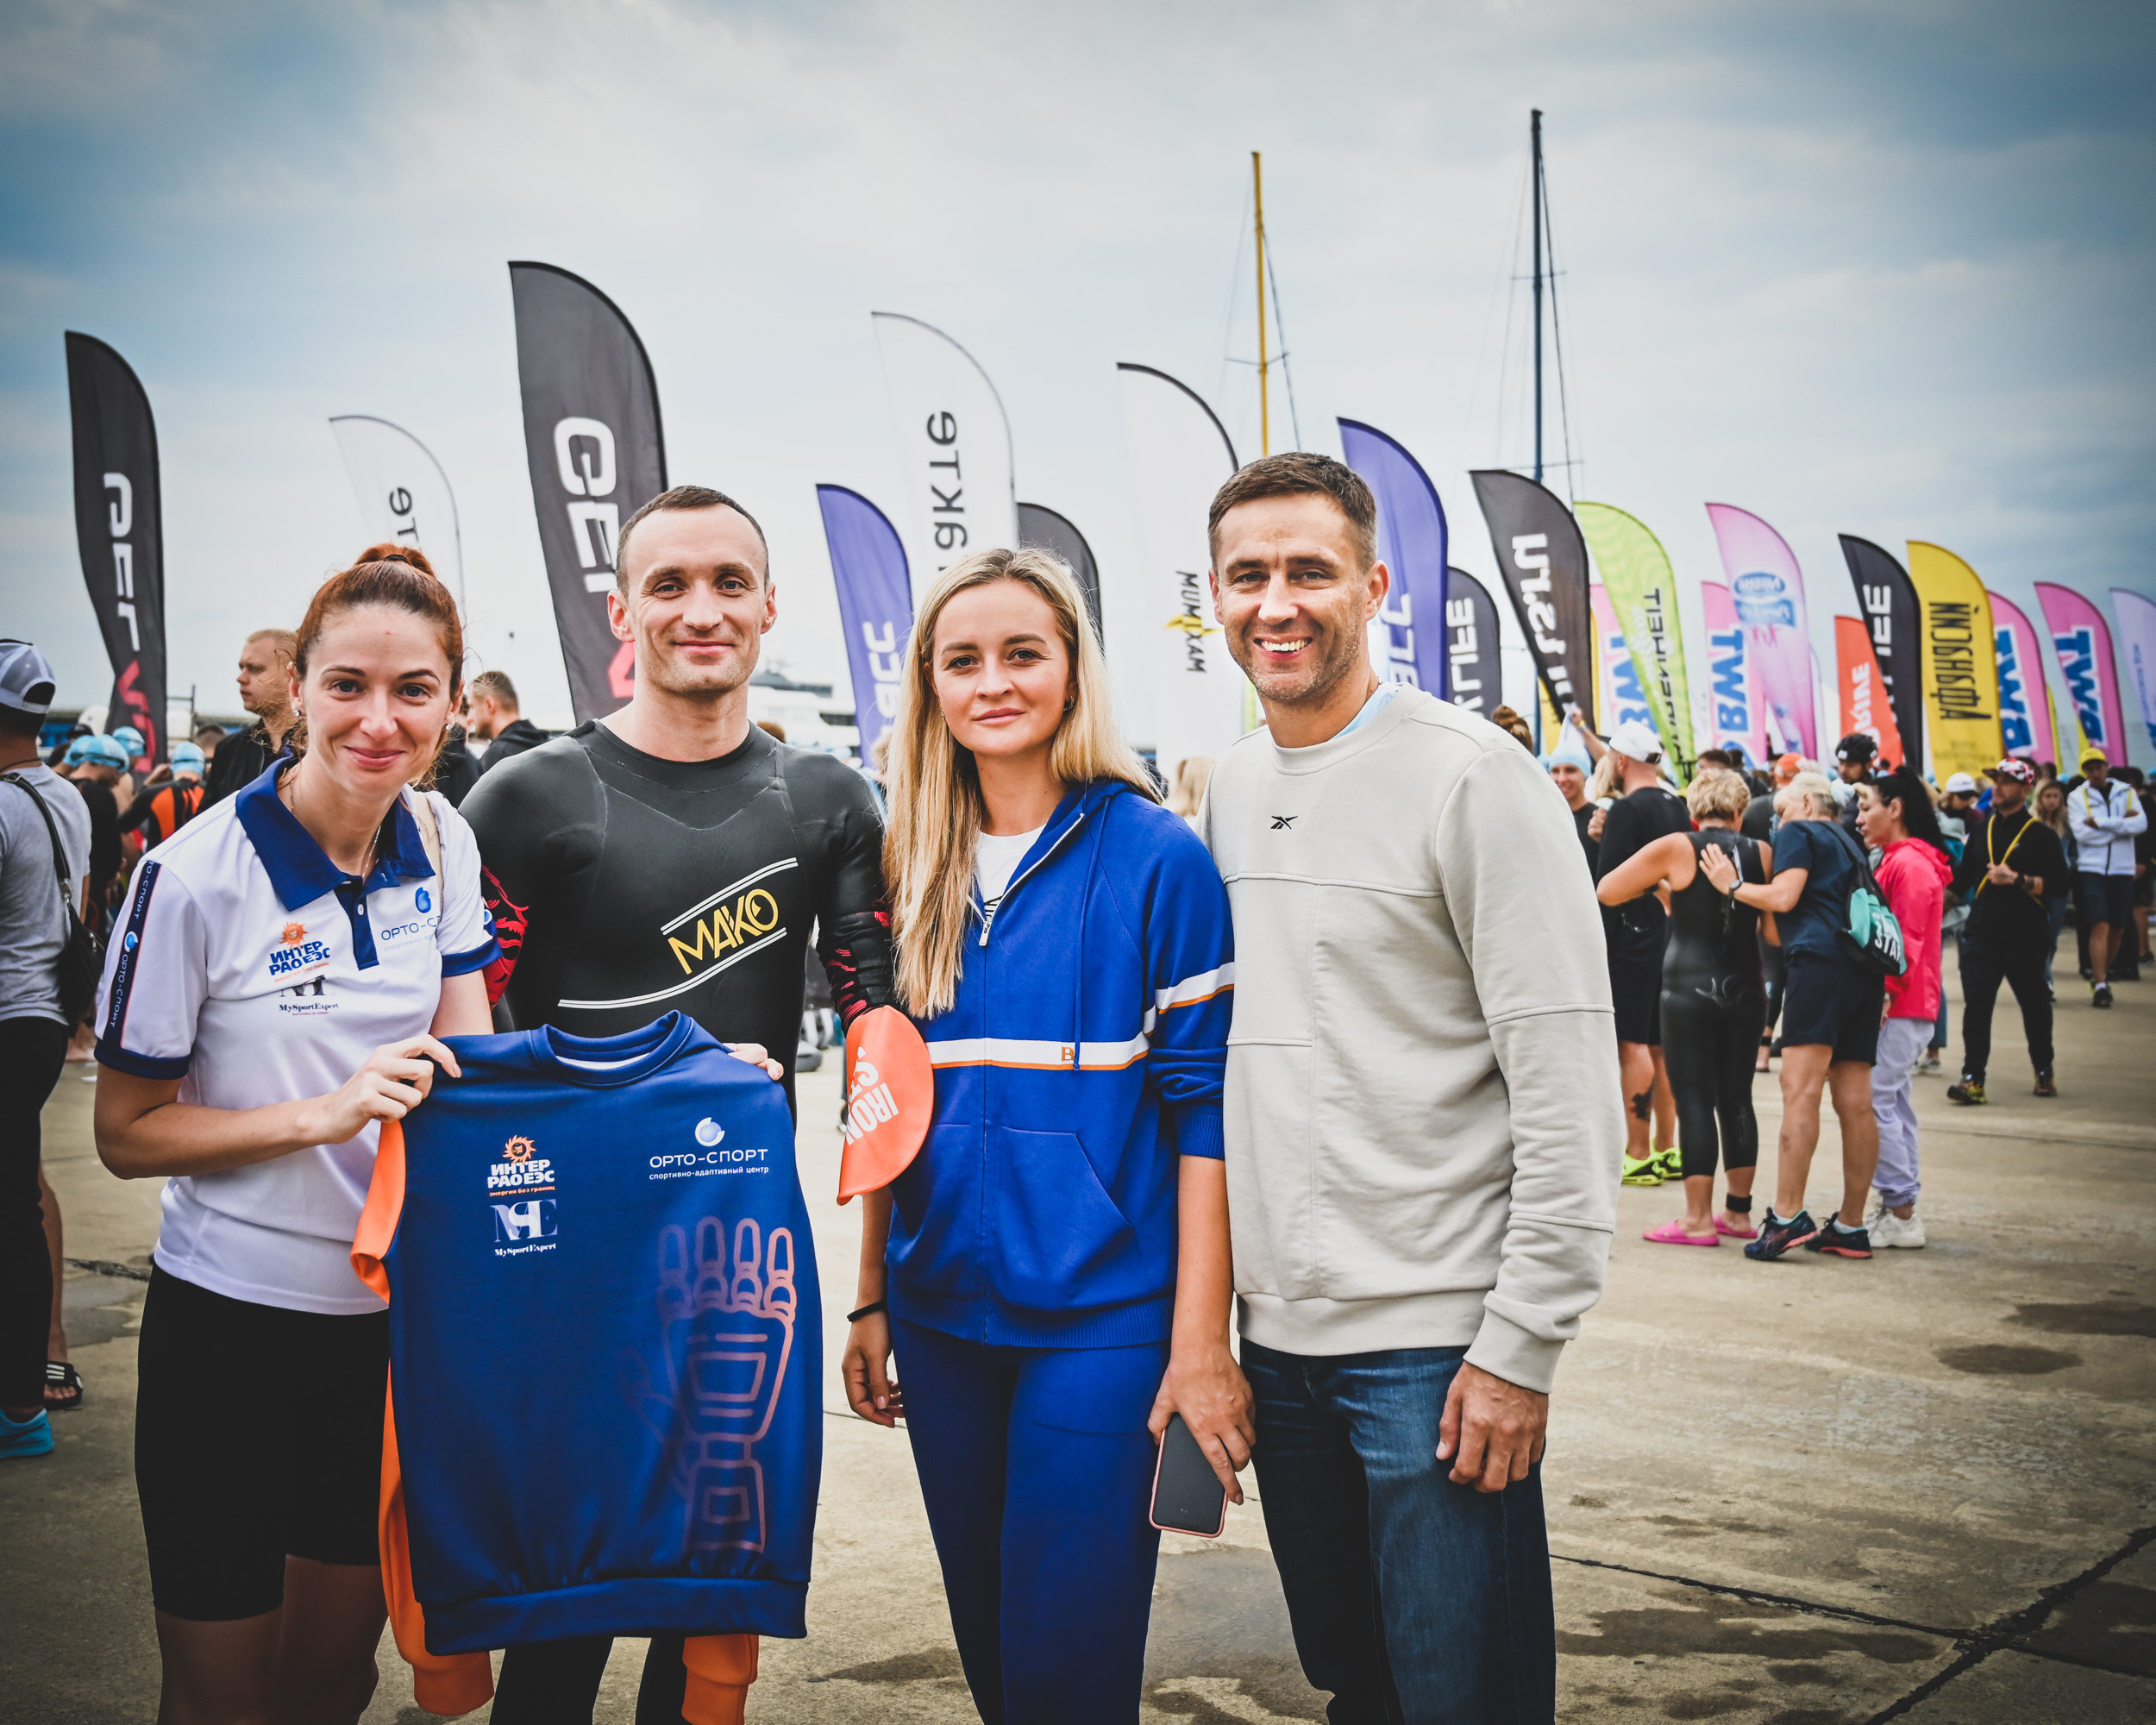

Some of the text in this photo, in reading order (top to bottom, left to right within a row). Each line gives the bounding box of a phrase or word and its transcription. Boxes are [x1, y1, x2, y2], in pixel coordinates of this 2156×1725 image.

[667, 888, 779, 975] MAKO
[270, 941, 323, 964] ИНТЕР
[110, 953, 128, 1028] ОРТО-СПОРТ
[845, 1082, 899, 1145] IRON
[491, 1158, 551, 1176] ИНТЕР
[649, 1148, 768, 1168] ОРТО-СПОРТ
[649, 1165, 769, 1181] спортивно-адаптивный центр
